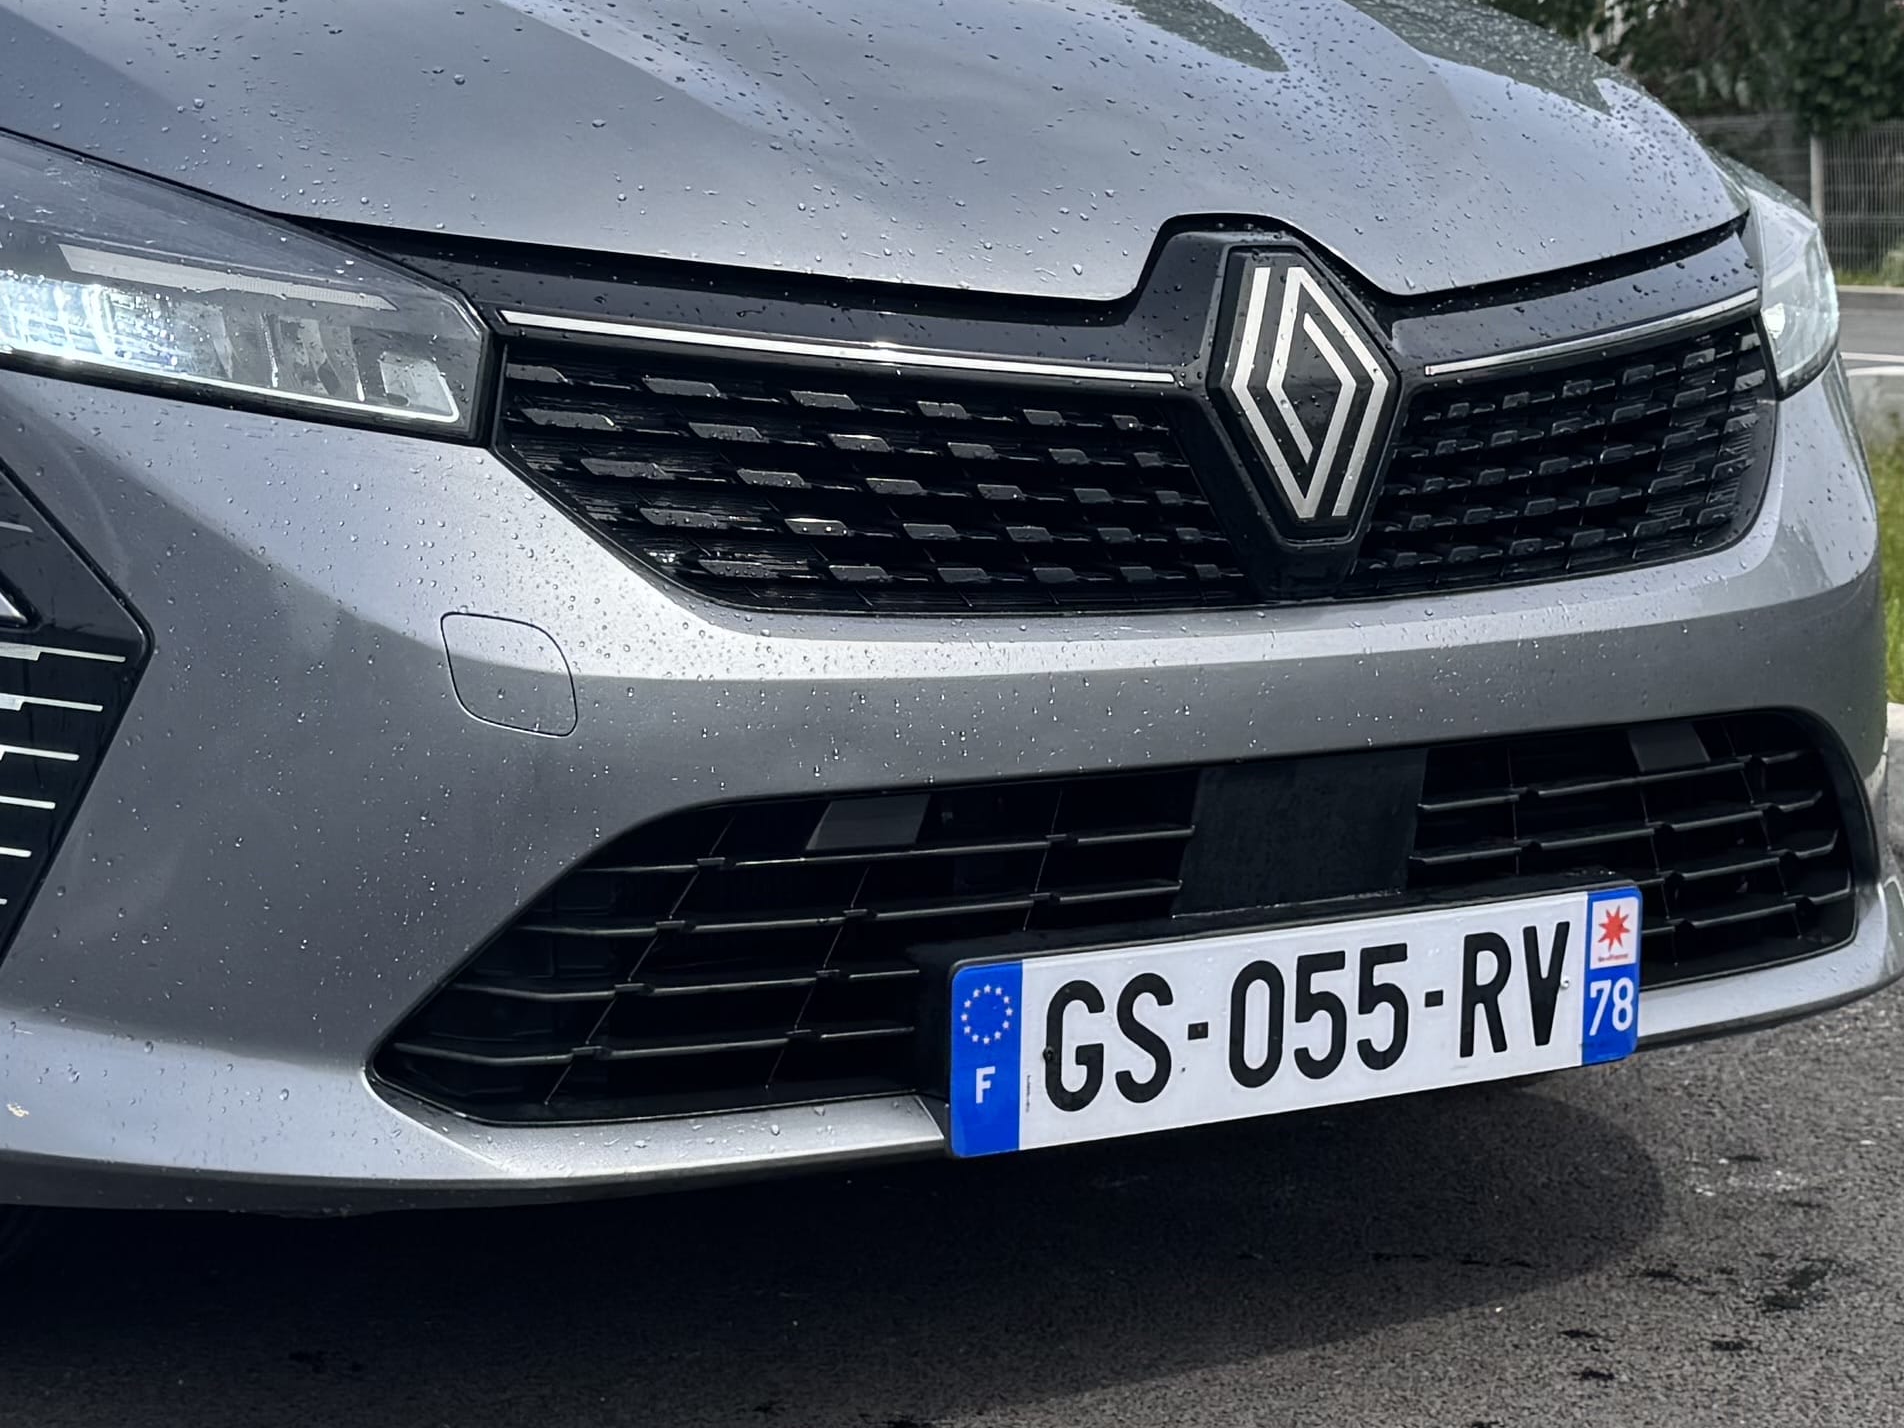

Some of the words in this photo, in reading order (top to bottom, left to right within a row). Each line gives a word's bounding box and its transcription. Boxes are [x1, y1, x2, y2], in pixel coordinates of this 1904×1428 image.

[1045, 921, 1571, 1113] GS-055-RV
[1589, 977, 1635, 1036] 78
[975, 1065, 996, 1104] F
